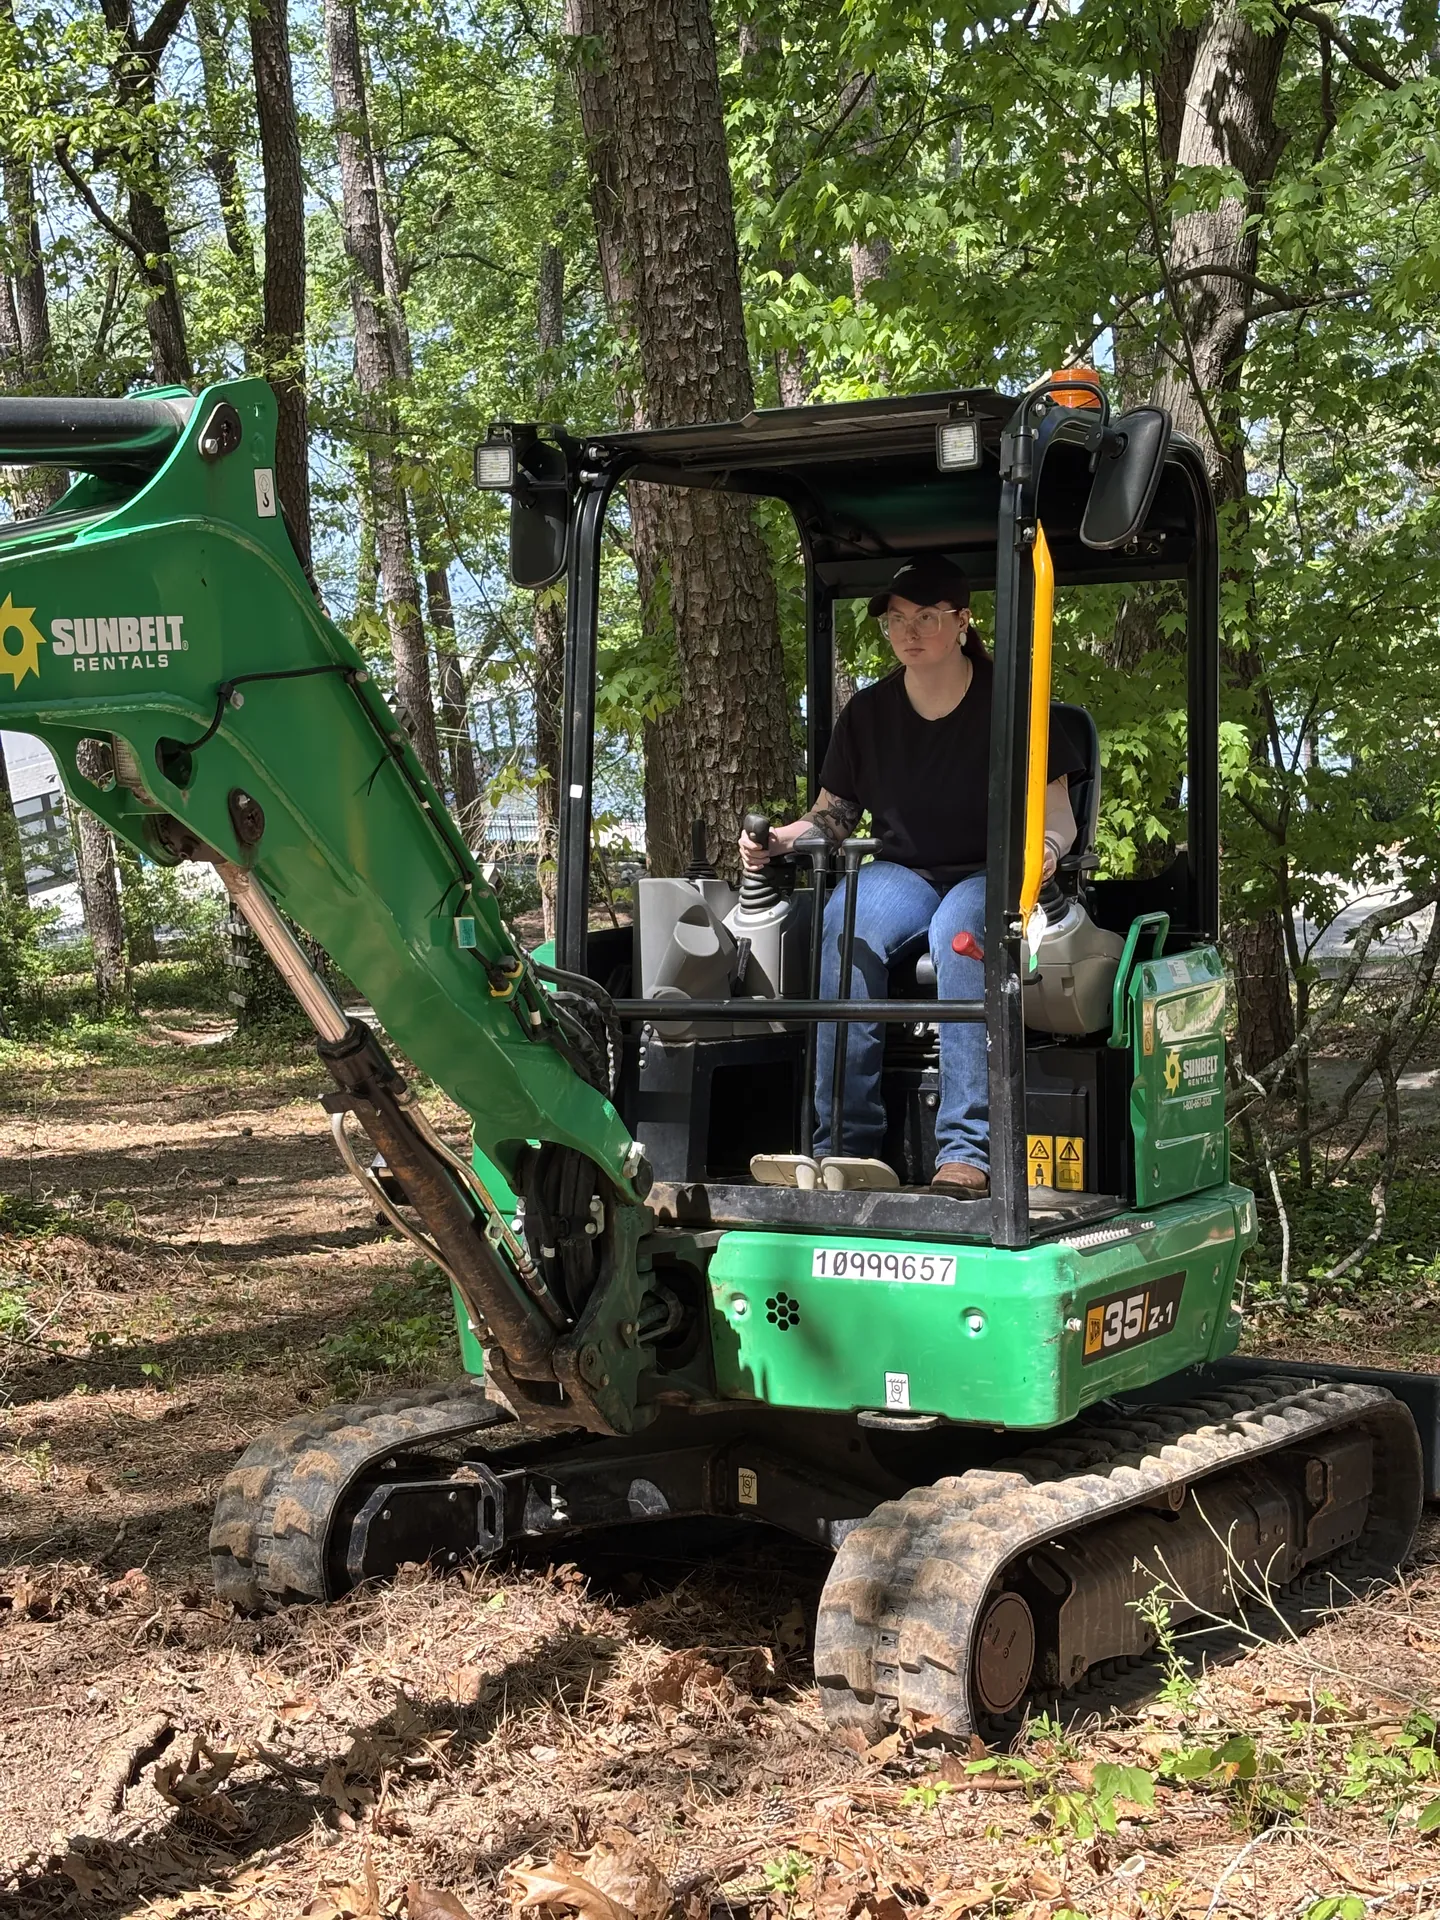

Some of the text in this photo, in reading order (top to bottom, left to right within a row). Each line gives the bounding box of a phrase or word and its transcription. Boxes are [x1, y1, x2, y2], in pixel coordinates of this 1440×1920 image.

[73, 654, 169, 672] RENTALS
[1183, 1055, 1219, 1079] SUNBELT
[1187, 1074, 1214, 1087] RENTALS
[816, 1250, 954, 1282] 10999657
[1103, 1293, 1145, 1347] 35
